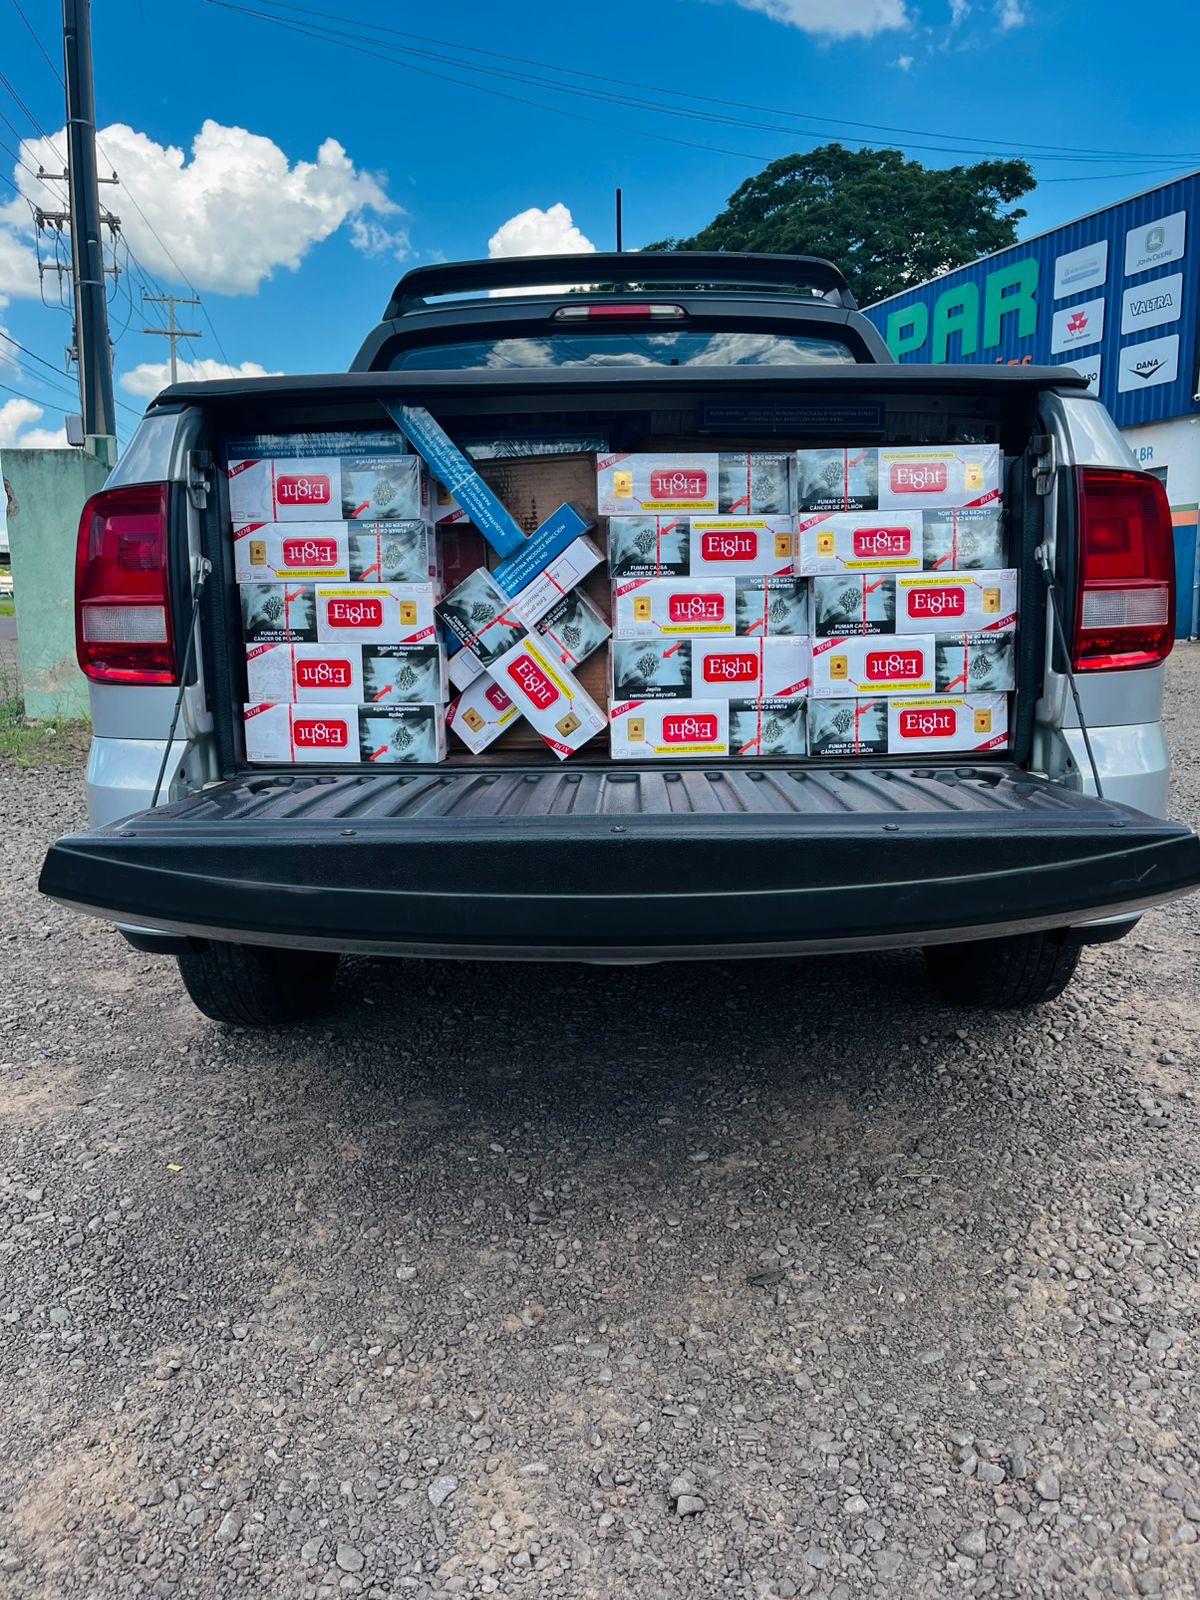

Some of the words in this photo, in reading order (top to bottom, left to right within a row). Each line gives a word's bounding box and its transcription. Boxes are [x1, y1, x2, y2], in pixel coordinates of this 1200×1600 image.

[1136, 258, 1151, 267] JOHN
[1153, 250, 1172, 262] DEERE
[887, 257, 1039, 364] PAR
[1130, 294, 1172, 316] VALTRA
[1136, 359, 1158, 370] DANA
[600, 456, 616, 469] BOX
[282, 479, 324, 499] Eight
[656, 473, 701, 494] Eight
[896, 469, 941, 489] Eight
[980, 490, 997, 505] BOX
[236, 527, 251, 539] BOX
[859, 531, 905, 553] Eight
[288, 541, 333, 563] Eight
[506, 560, 528, 580] NICOTINA
[525, 542, 546, 562] PRODUCE
[544, 524, 566, 545] ADICCIÓN
[708, 537, 752, 557] Eight
[503, 578, 519, 592] UMAR
[517, 563, 535, 580] LLAMAR
[539, 551, 548, 560] 140
[621, 581, 636, 596] BOX
[333, 603, 377, 624] Eight
[552, 606, 567, 621] FUMAR
[675, 597, 719, 617] Eight
[914, 594, 959, 614] Eight
[415, 629, 432, 641] BOX
[443, 613, 460, 632] CÁNCER
[457, 630, 465, 638] DE
[463, 636, 481, 655] PLMÓN
[451, 615, 467, 631] FUMAR
[465, 629, 480, 646] CASA
[539, 619, 553, 633] CASA
[248, 647, 263, 659] BOX
[816, 640, 832, 654] BOX
[302, 663, 346, 683] Eight
[709, 659, 752, 678] Eight
[872, 655, 918, 676] Eight
[515, 660, 552, 703] Eight
[790, 682, 806, 693] BOX
[245, 706, 261, 718] BOX
[614, 704, 630, 716] BOX
[299, 723, 342, 743] Eight
[668, 718, 713, 738] Eight
[906, 713, 951, 734] Eight
[553, 742, 570, 753] BOX
[989, 735, 1005, 748] BOX
